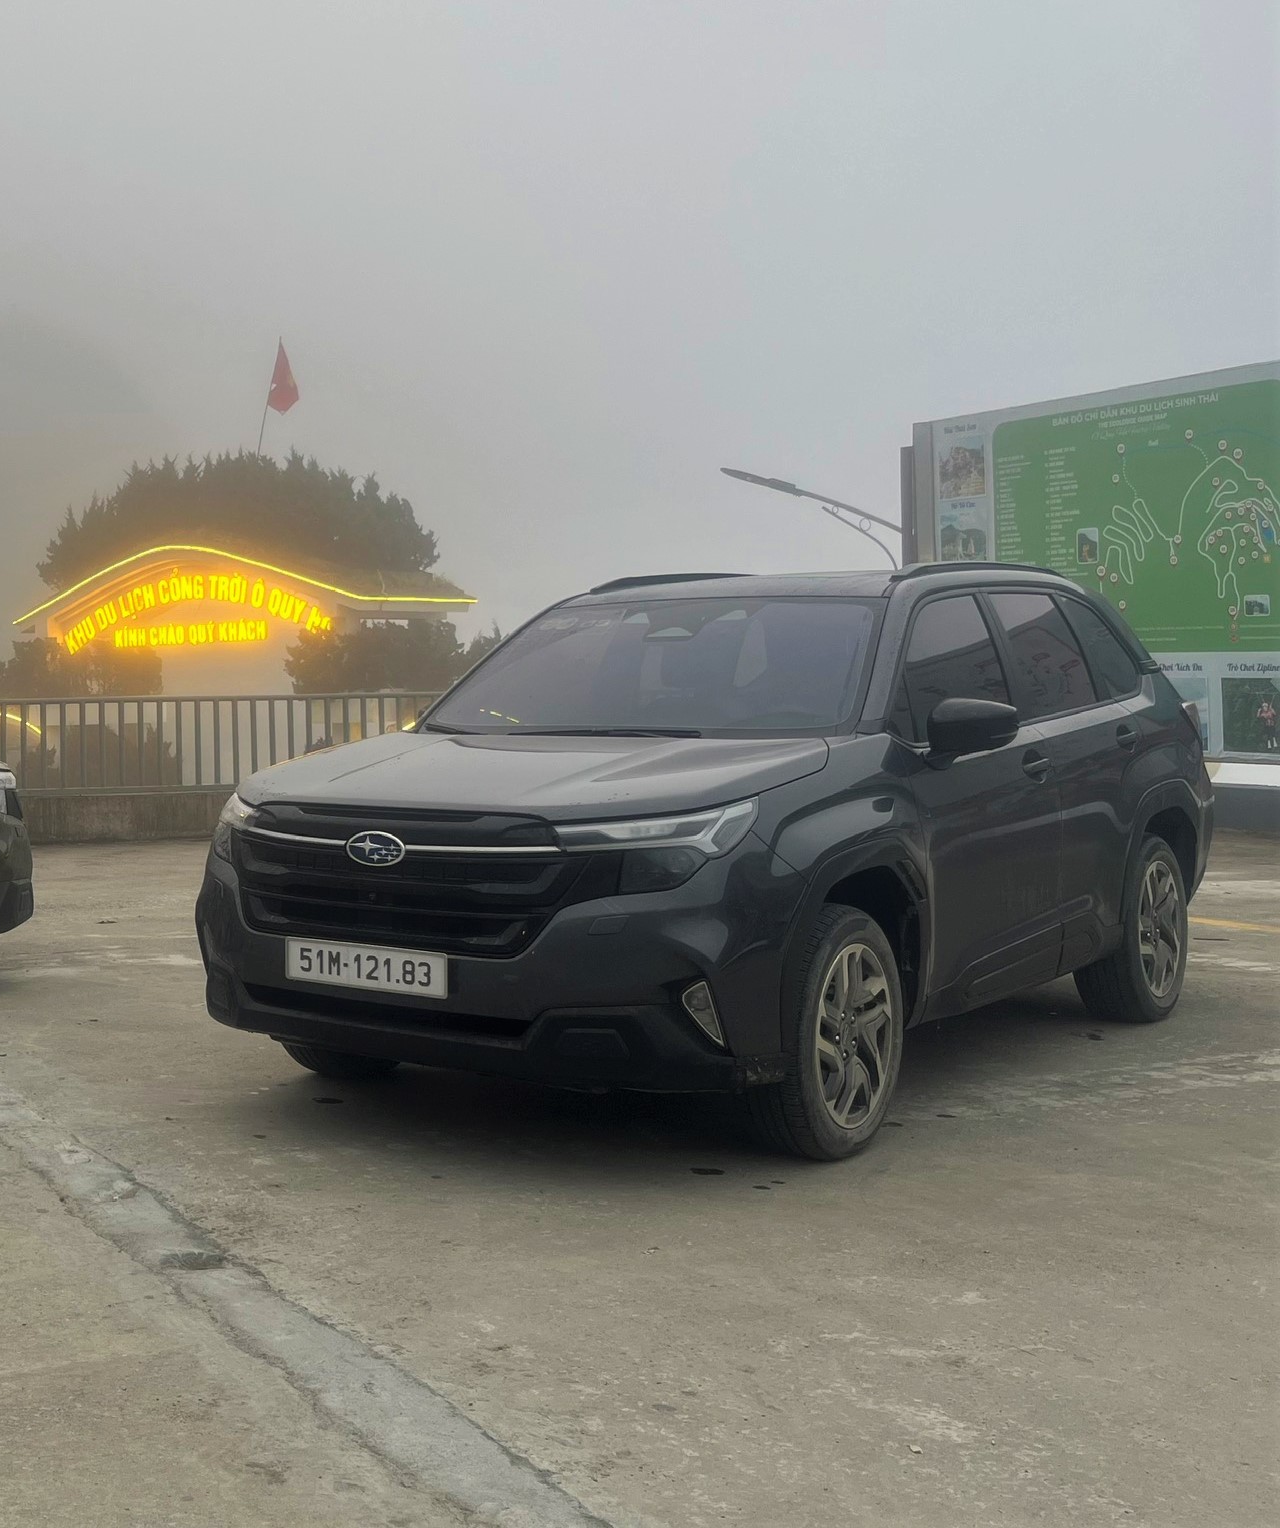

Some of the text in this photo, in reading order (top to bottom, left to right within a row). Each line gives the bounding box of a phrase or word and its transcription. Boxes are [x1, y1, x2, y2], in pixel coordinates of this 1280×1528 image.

[1120, 406, 1138, 416] KHU
[1139, 404, 1152, 413] DU
[1175, 396, 1196, 409] SINH
[64, 617, 97, 655] KHU
[94, 605, 118, 631] DU
[118, 582, 156, 620] LỊCH
[157, 567, 204, 604] CỔNG
[208, 572, 248, 604] TRỜI
[251, 577, 266, 609] Ô
[267, 588, 307, 624] QUY
[114, 618, 267, 648] KÍNH CHÀO QUÝ KHÁCH
[300, 947, 431, 987] 51M-121.83
